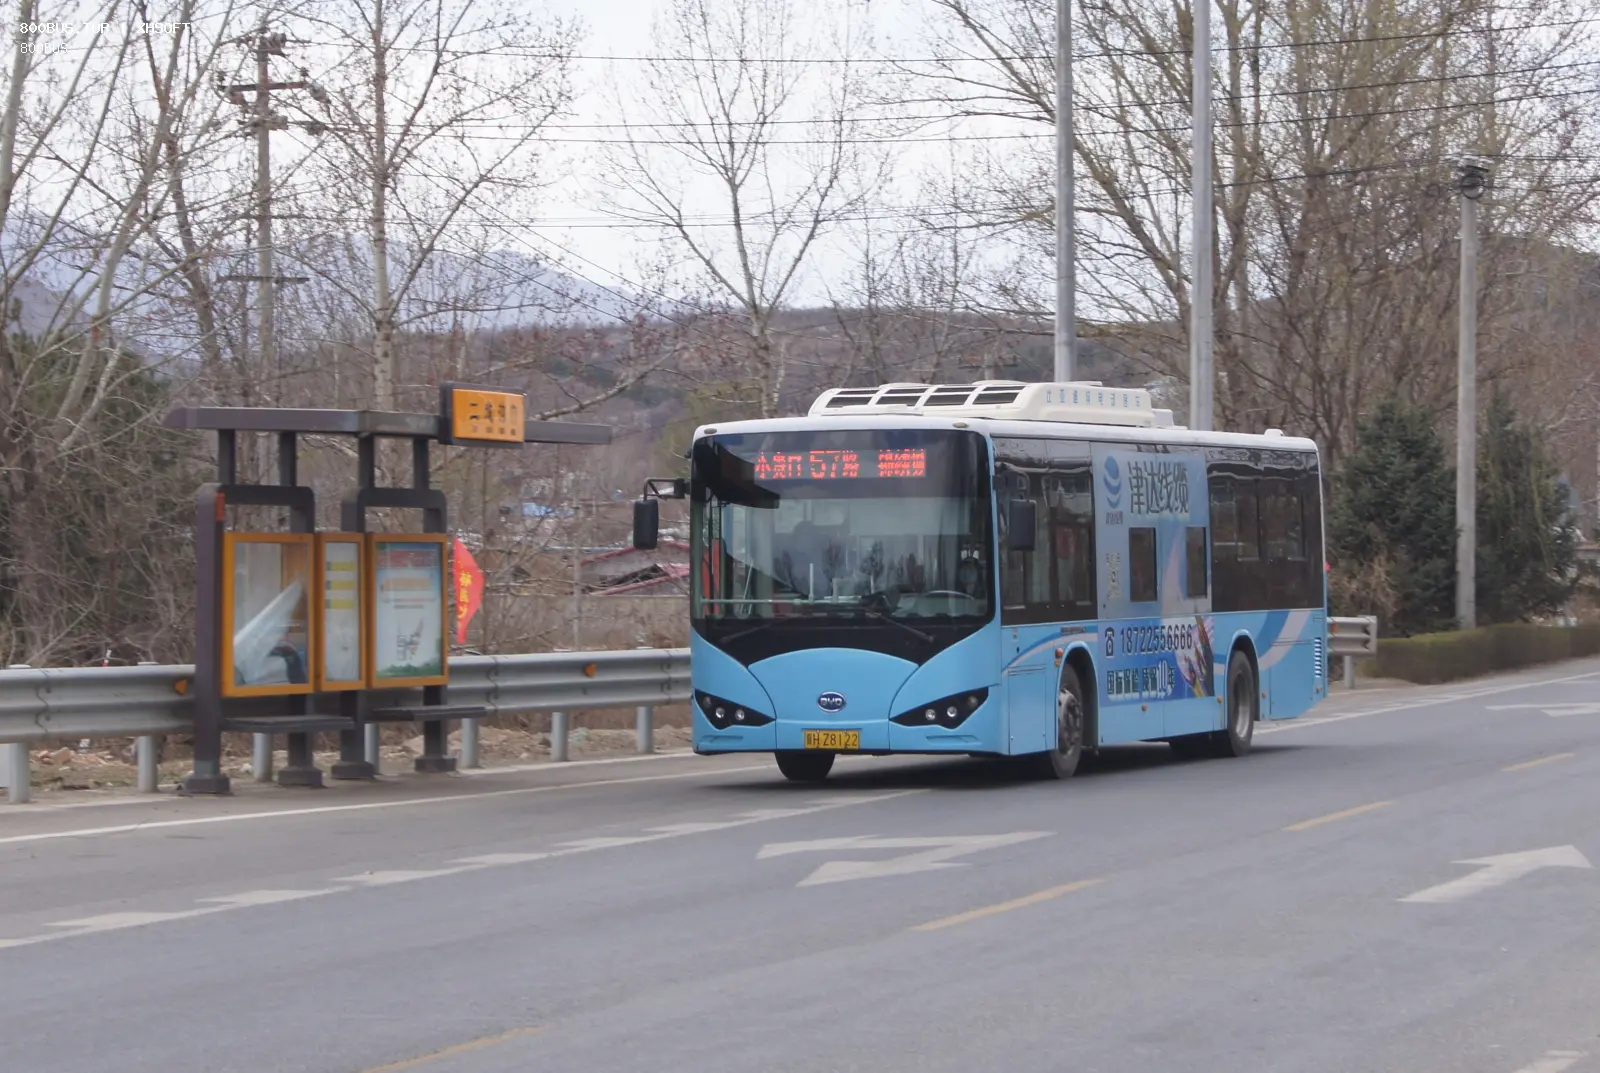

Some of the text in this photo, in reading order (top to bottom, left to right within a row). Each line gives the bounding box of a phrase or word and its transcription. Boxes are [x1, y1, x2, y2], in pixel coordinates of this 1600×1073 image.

[1127, 460, 1188, 514] 津达线缆
[1120, 624, 1193, 655] 18722556666
[820, 697, 843, 706] BYD
